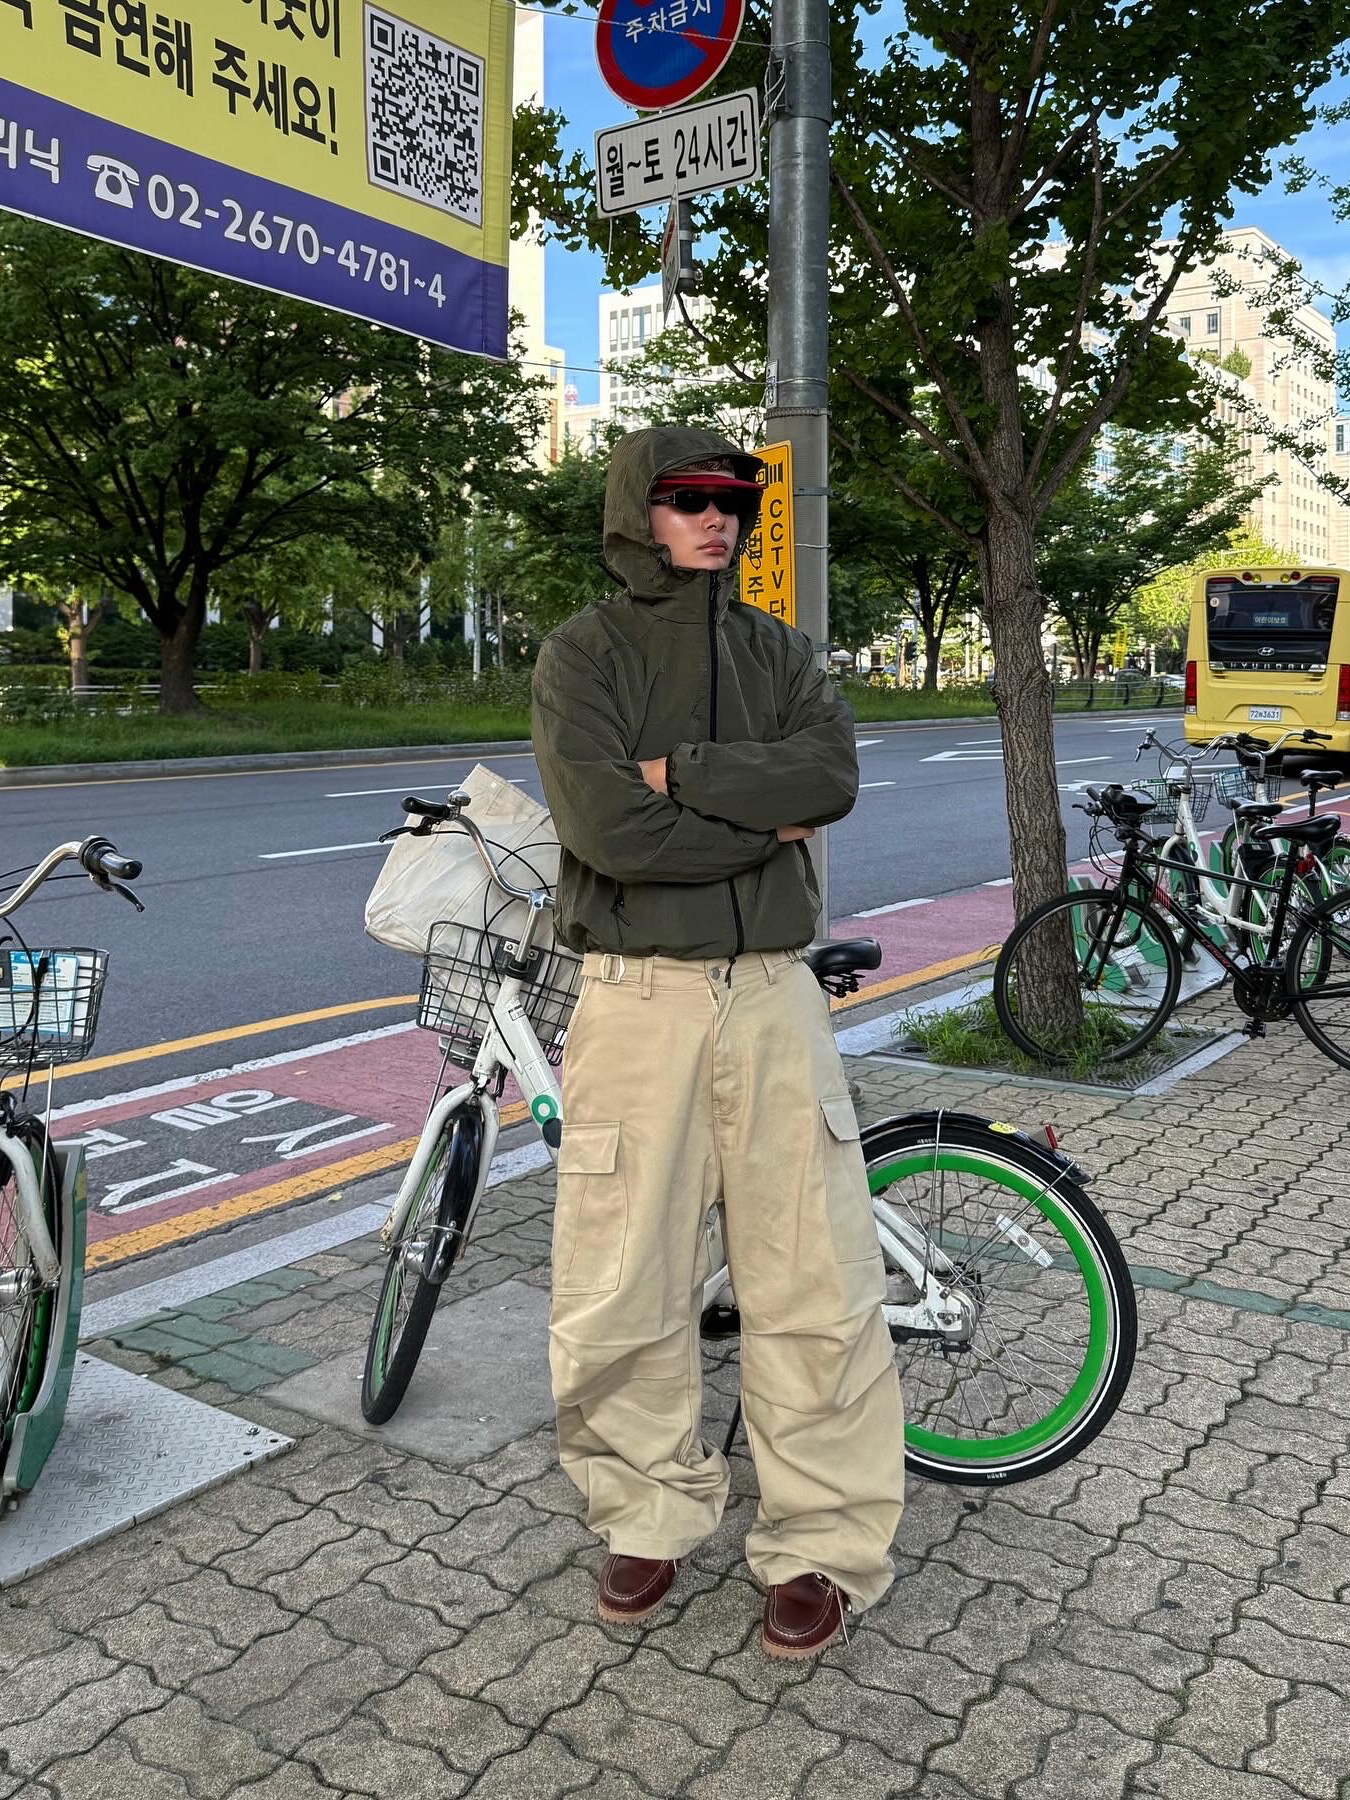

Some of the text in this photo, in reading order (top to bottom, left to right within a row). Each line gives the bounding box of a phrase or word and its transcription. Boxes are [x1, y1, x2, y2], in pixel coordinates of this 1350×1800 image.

[58, 0, 339, 156] 금연해 주세요!
[605, 111, 748, 198] 월~토 24시간
[147, 174, 446, 308] 02-2670-4781~4
[769, 499, 785, 590] CCTV
[1230, 662, 1304, 670] HYUNDAI
